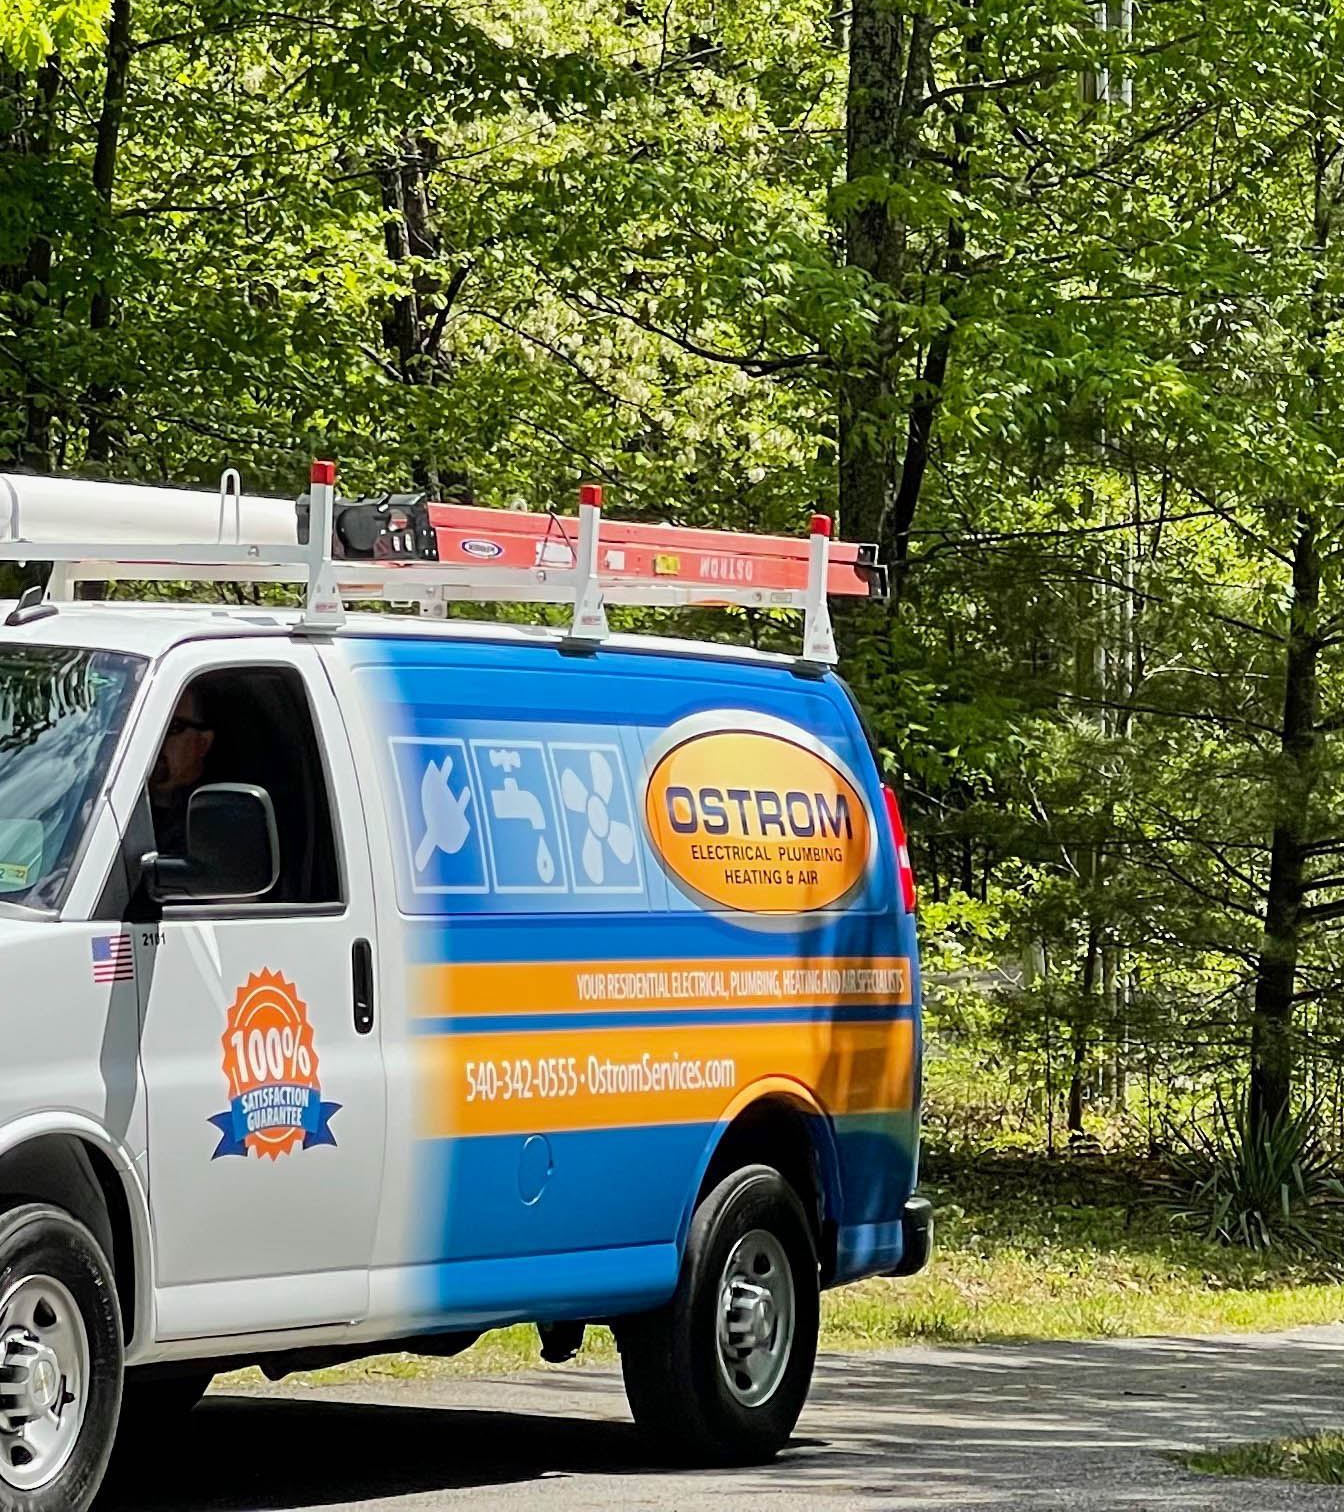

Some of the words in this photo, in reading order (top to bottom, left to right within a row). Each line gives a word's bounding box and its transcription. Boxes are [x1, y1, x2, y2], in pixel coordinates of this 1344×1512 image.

[699, 555, 754, 582] OSTROM
[665, 786, 853, 840] OSTROM
[691, 844, 771, 861] ELECTRICAL
[779, 846, 843, 862] PLUMBING
[724, 869, 782, 885] HEATING
[786, 870, 794, 884] &
[798, 870, 819, 885] AIR
[576, 973, 605, 1000] YOUR
[607, 972, 671, 999] RESIDENTIAL
[672, 970, 729, 1000] ELECTRICAL,
[730, 969, 782, 999] PLUMBING,
[783, 969, 821, 995] HEATING
[822, 969, 841, 994] AND
[231, 1025, 311, 1083] 100%
[466, 1057, 577, 1102] 540-342-0555
[587, 1051, 736, 1094] OstromServices.com
[241, 1086, 310, 1114] SATISFACTION
[247, 1106, 302, 1131] GUARANTEE
